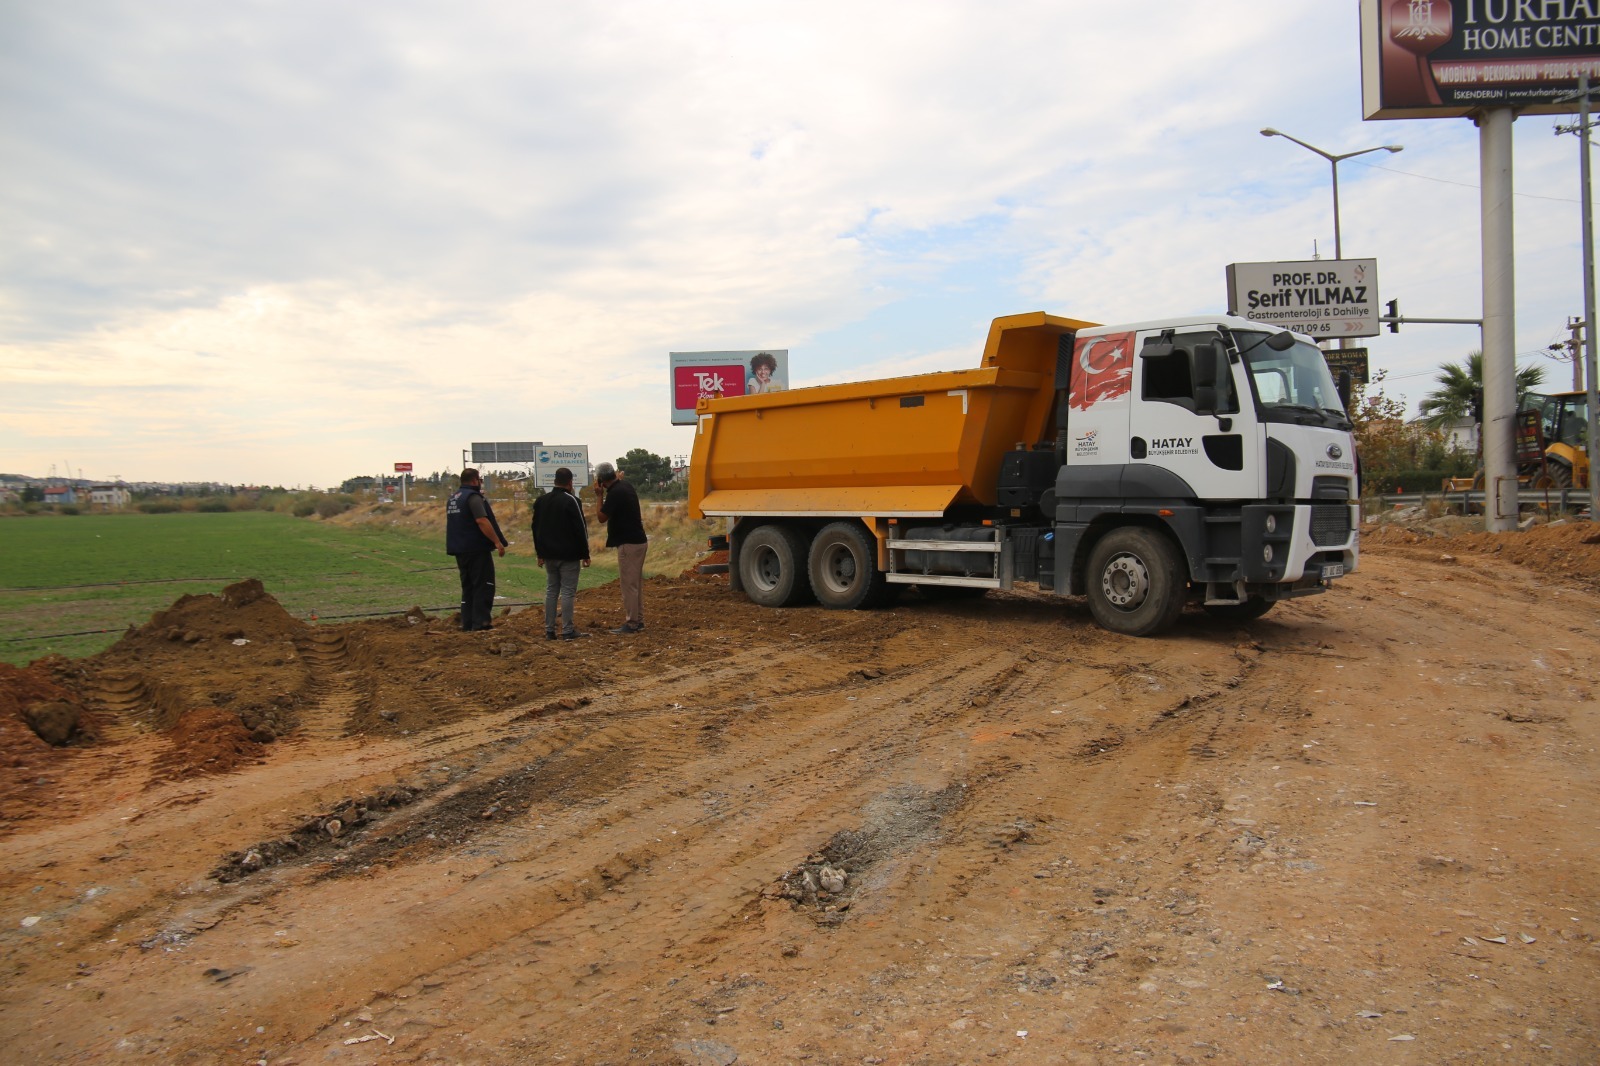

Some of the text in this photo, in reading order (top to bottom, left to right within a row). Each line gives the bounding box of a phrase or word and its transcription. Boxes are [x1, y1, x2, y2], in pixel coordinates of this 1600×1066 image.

[1464, 0, 1600, 24] TURHA
[1463, 24, 1600, 51] HOME CENT
[1483, 64, 1538, 82] DEKORASYON
[1544, 63, 1569, 79] PERDE
[1453, 89, 1503, 99] İSKENDERUN
[1273, 271, 1341, 286] PROF. DR.
[1247, 286, 1368, 309] Şerif YILMAZ
[1247, 306, 1369, 320] Gastroenteroloji & Dahiliye
[1291, 324, 1305, 333] 671
[1306, 324, 1319, 332] 09
[1320, 323, 1331, 332] 65
[693, 372, 725, 392] Tek
[1152, 438, 1193, 448] HATAY
[553, 450, 583, 460] Palmiye
